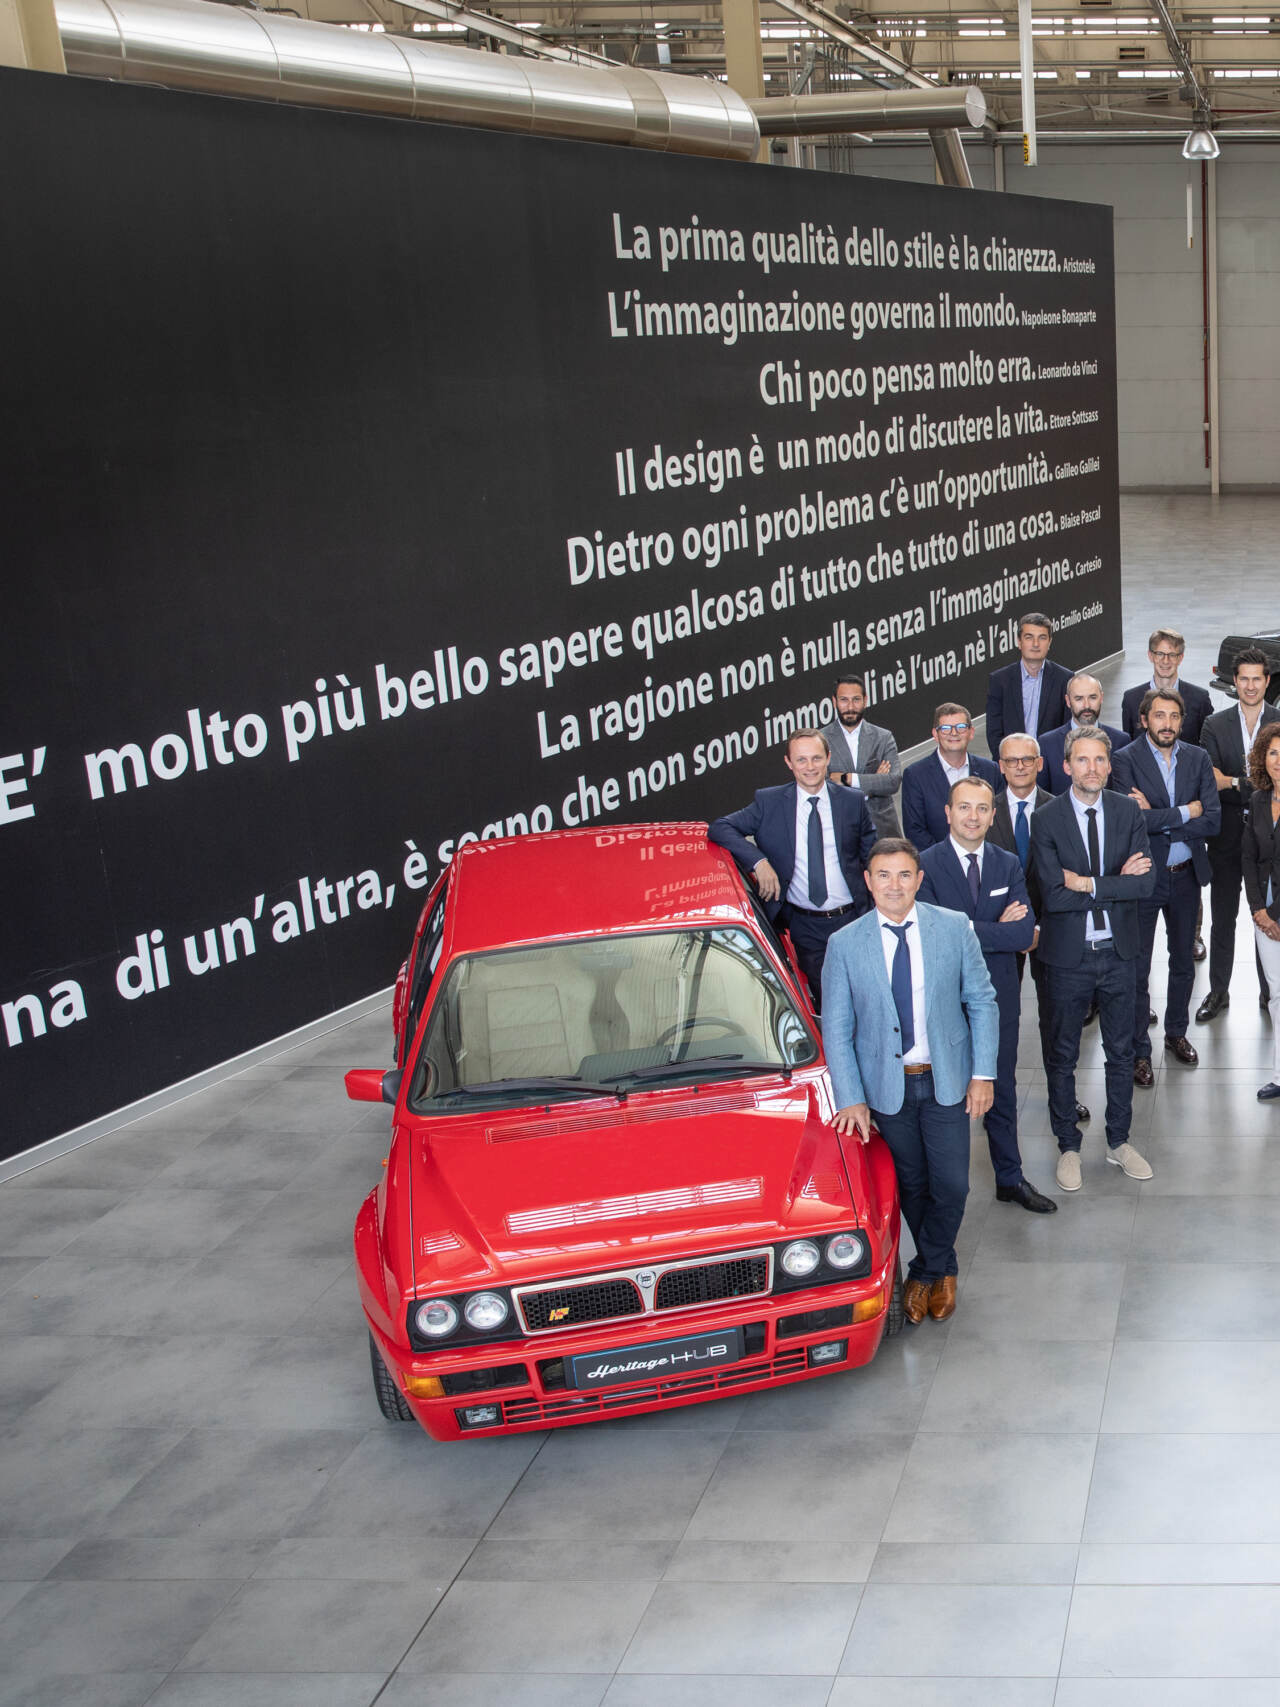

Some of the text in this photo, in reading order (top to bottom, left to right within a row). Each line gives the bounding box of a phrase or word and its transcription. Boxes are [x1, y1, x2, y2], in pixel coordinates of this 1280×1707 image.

[613, 213, 1095, 273] La prima qualità dello stile è la chiarezza. Aristotele
[608, 290, 1096, 345] L'immaginazione governa il mondo. Napoleone Bonaparte
[760, 350, 1097, 411] Chi poco pensa molto erra. Leonardo da Vinci
[616, 402, 1098, 496] Il design è un modo di discutere la vita. Ettore Sottsass
[567, 451, 1099, 585] Dietro ogni problema c'è un'opportunità. Galileo Galilei
[0, 505, 1100, 825] E' molto più bello sapere qualcosa di tutto che tutto di una cosa. Blaise Pascal
[537, 556, 1101, 758] La ragione non è nulla senza l'immaginazione. Cartesio
[116, 929, 170, 999] di
[184, 870, 395, 975] un'altra,
[404, 840, 427, 889] è
[562, 775, 620, 827] che
[628, 753, 686, 801] non
[693, 726, 758, 775] sono
[764, 669, 877, 747] immoli
[882, 660, 906, 700] nè
[910, 650, 961, 690] l'una,
[965, 630, 985, 667] nè
[989, 618, 1019, 658] l'alt
[1061, 610, 1081, 629] Emilio
[1082, 601, 1103, 621] Gadda
[549, 1307, 570, 1322] HF
[587, 1344, 728, 1379] Heritage HUB
